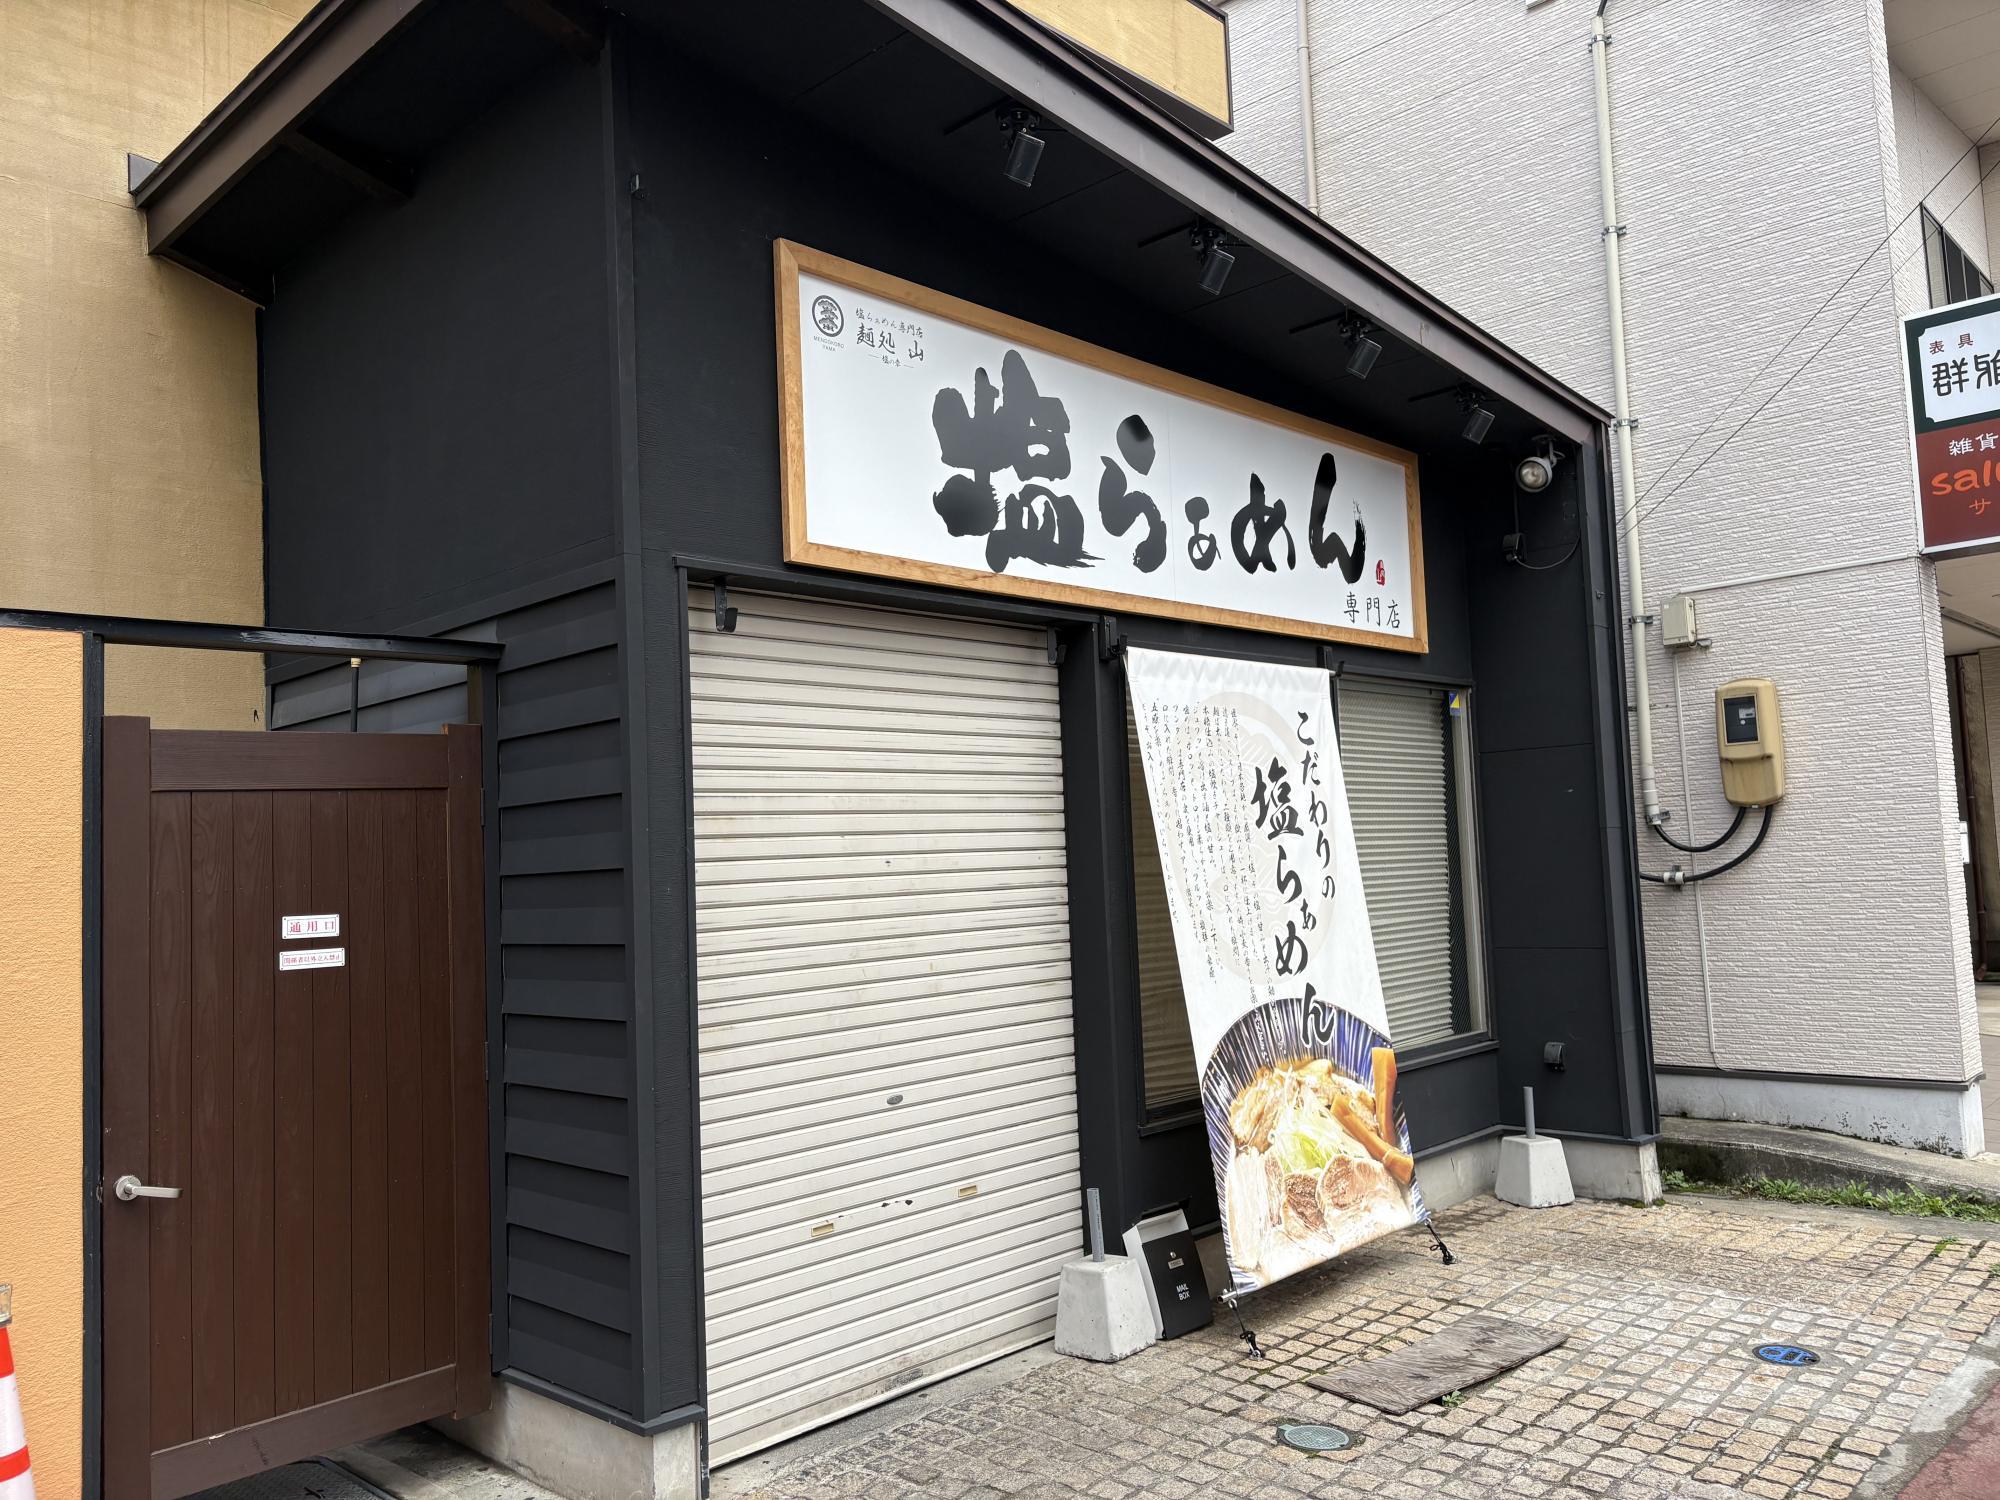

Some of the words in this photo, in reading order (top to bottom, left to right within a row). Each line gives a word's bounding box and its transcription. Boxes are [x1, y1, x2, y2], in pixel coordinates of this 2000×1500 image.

[908, 340, 924, 362] 山
[1948, 432, 1999, 457] 雑貨
[931, 348, 1368, 585] 塩らぁめん
[1931, 460, 2000, 496] sal
[1343, 591, 1401, 629] 専門店
[1296, 710, 1336, 903] こだわりの
[1249, 757, 1336, 1048] 塩らぁめん
[289, 920, 334, 933] 通用口
[1176, 1283, 1189, 1293] MAIL
[1178, 1291, 1190, 1301] BOX
